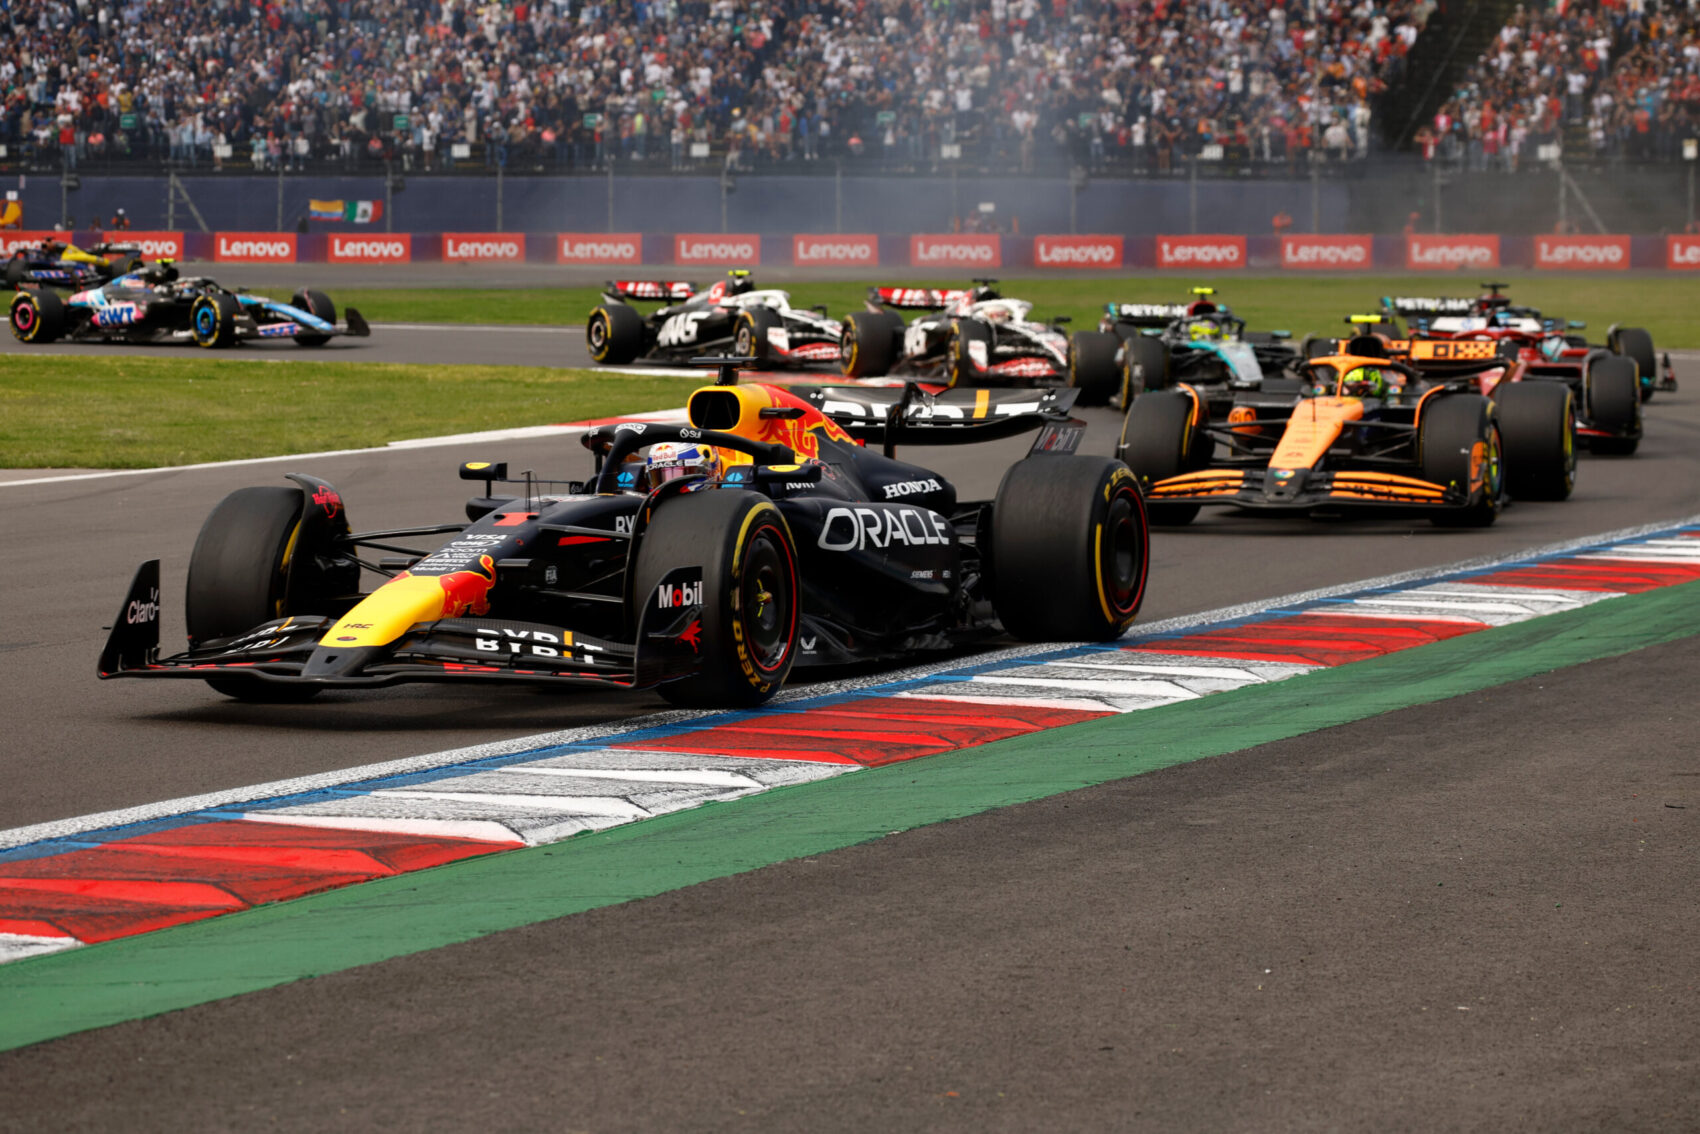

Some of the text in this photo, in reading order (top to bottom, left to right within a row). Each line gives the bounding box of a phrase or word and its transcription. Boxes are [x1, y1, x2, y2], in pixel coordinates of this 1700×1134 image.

[0, 238, 42, 254] Leno
[221, 240, 290, 256] Lenovo
[335, 240, 403, 257] Lenovo
[447, 239, 518, 258] Lenovo
[563, 240, 635, 258] Lenovo
[681, 242, 753, 259] Lenovo
[798, 242, 870, 260] Lenovo
[918, 243, 993, 260] Lenovo
[1039, 243, 1115, 262] Lenovo
[1162, 243, 1239, 262] Lenovo
[1286, 243, 1365, 262] Lenovo
[1411, 243, 1492, 262] Lenovo
[1540, 243, 1623, 262] Lenovo
[100, 306, 134, 327] BWT
[647, 460, 683, 472] ORACLE
[883, 478, 943, 500] HONDA
[818, 507, 950, 551] ORACLE
[658, 581, 703, 609] Mobil
[127, 600, 155, 625] Claro
